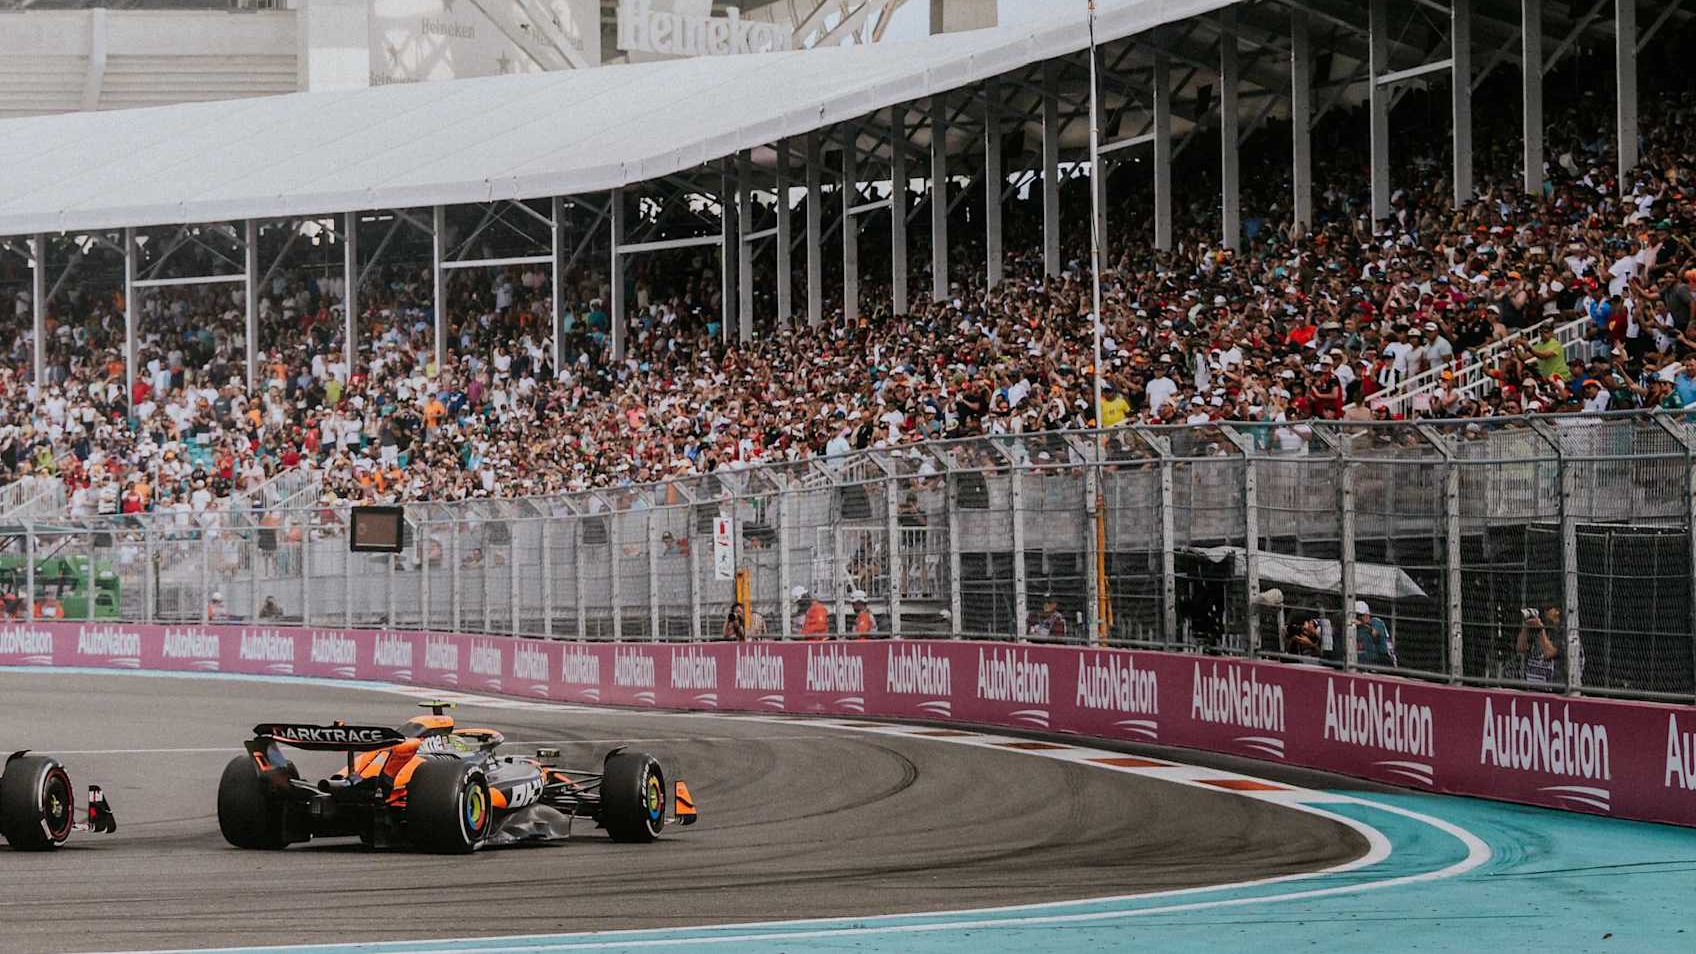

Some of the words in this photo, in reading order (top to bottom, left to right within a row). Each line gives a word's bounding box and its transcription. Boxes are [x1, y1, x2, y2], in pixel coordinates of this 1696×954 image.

[421, 18, 476, 39] Heineken
[78, 626, 140, 656] AutoNation
[162, 627, 220, 658] AutoNation
[240, 629, 294, 662] AutoNation
[310, 630, 356, 665] AutoNation
[373, 632, 412, 667] AutoNation
[424, 633, 458, 670] AutoNation
[470, 637, 502, 676] AutoNation
[513, 641, 548, 681] AutoNation
[562, 644, 600, 685] AutoNation
[614, 645, 655, 687] AutoNation
[670, 645, 717, 689] AutoNation
[735, 644, 784, 691] AutoNation
[806, 644, 864, 692] AutoNation
[887, 644, 951, 696] AutoNation
[977, 646, 1049, 704] AutoNation
[1076, 652, 1158, 714] AutoNation
[1191, 660, 1284, 732] AutoNation
[272, 727, 383, 742] DARKTRACE
[1324, 676, 1434, 758] AutoNation
[1480, 696, 1610, 780] AutoNation
